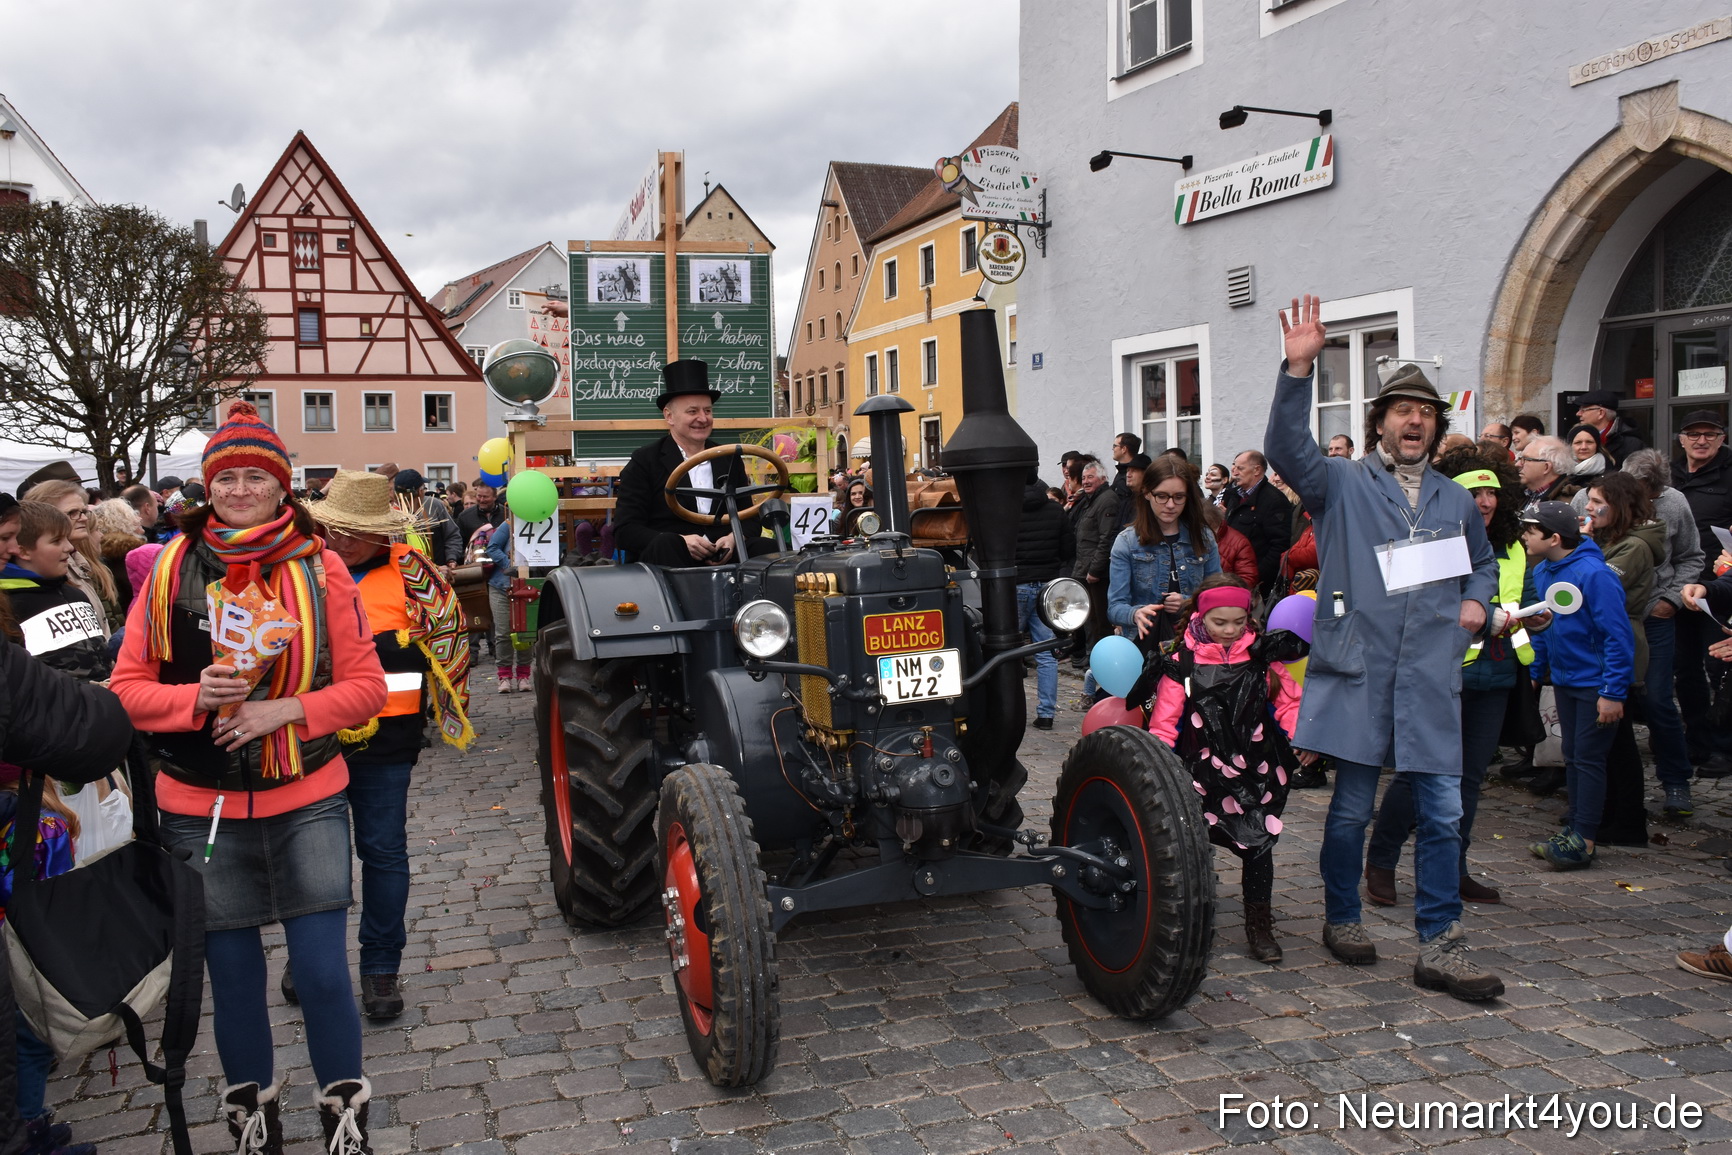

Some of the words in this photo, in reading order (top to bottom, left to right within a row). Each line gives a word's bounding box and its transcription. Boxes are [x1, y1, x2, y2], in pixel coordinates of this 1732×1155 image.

[1581, 55, 1620, 77] GEORG
[979, 148, 1020, 162] Pizzeria
[989, 164, 1011, 176] Café
[1203, 169, 1233, 184] Pizzeria
[1241, 160, 1260, 175] Café
[1267, 149, 1300, 166] Eisdiele
[978, 177, 1021, 191] Eisdiele
[1198, 184, 1242, 214] Bella
[1247, 172, 1302, 200] Roma
[966, 206, 998, 215] Roma
[986, 201, 1015, 210] Bella
[571, 328, 601, 346] Das
[607, 334, 646, 347] neue
[683, 324, 712, 346] Wir
[718, 323, 764, 347] haben
[715, 351, 764, 370] schon
[575, 375, 664, 402] Schulkonzept
[518, 516, 554, 544] 42
[794, 507, 828, 535] 42
[882, 615, 926, 633] LANZ
[869, 631, 940, 650] BULLDOG
[884, 670, 890, 678] D
[895, 656, 922, 678] NM
[897, 678, 923, 699] LZ
[926, 676, 939, 696] 2
